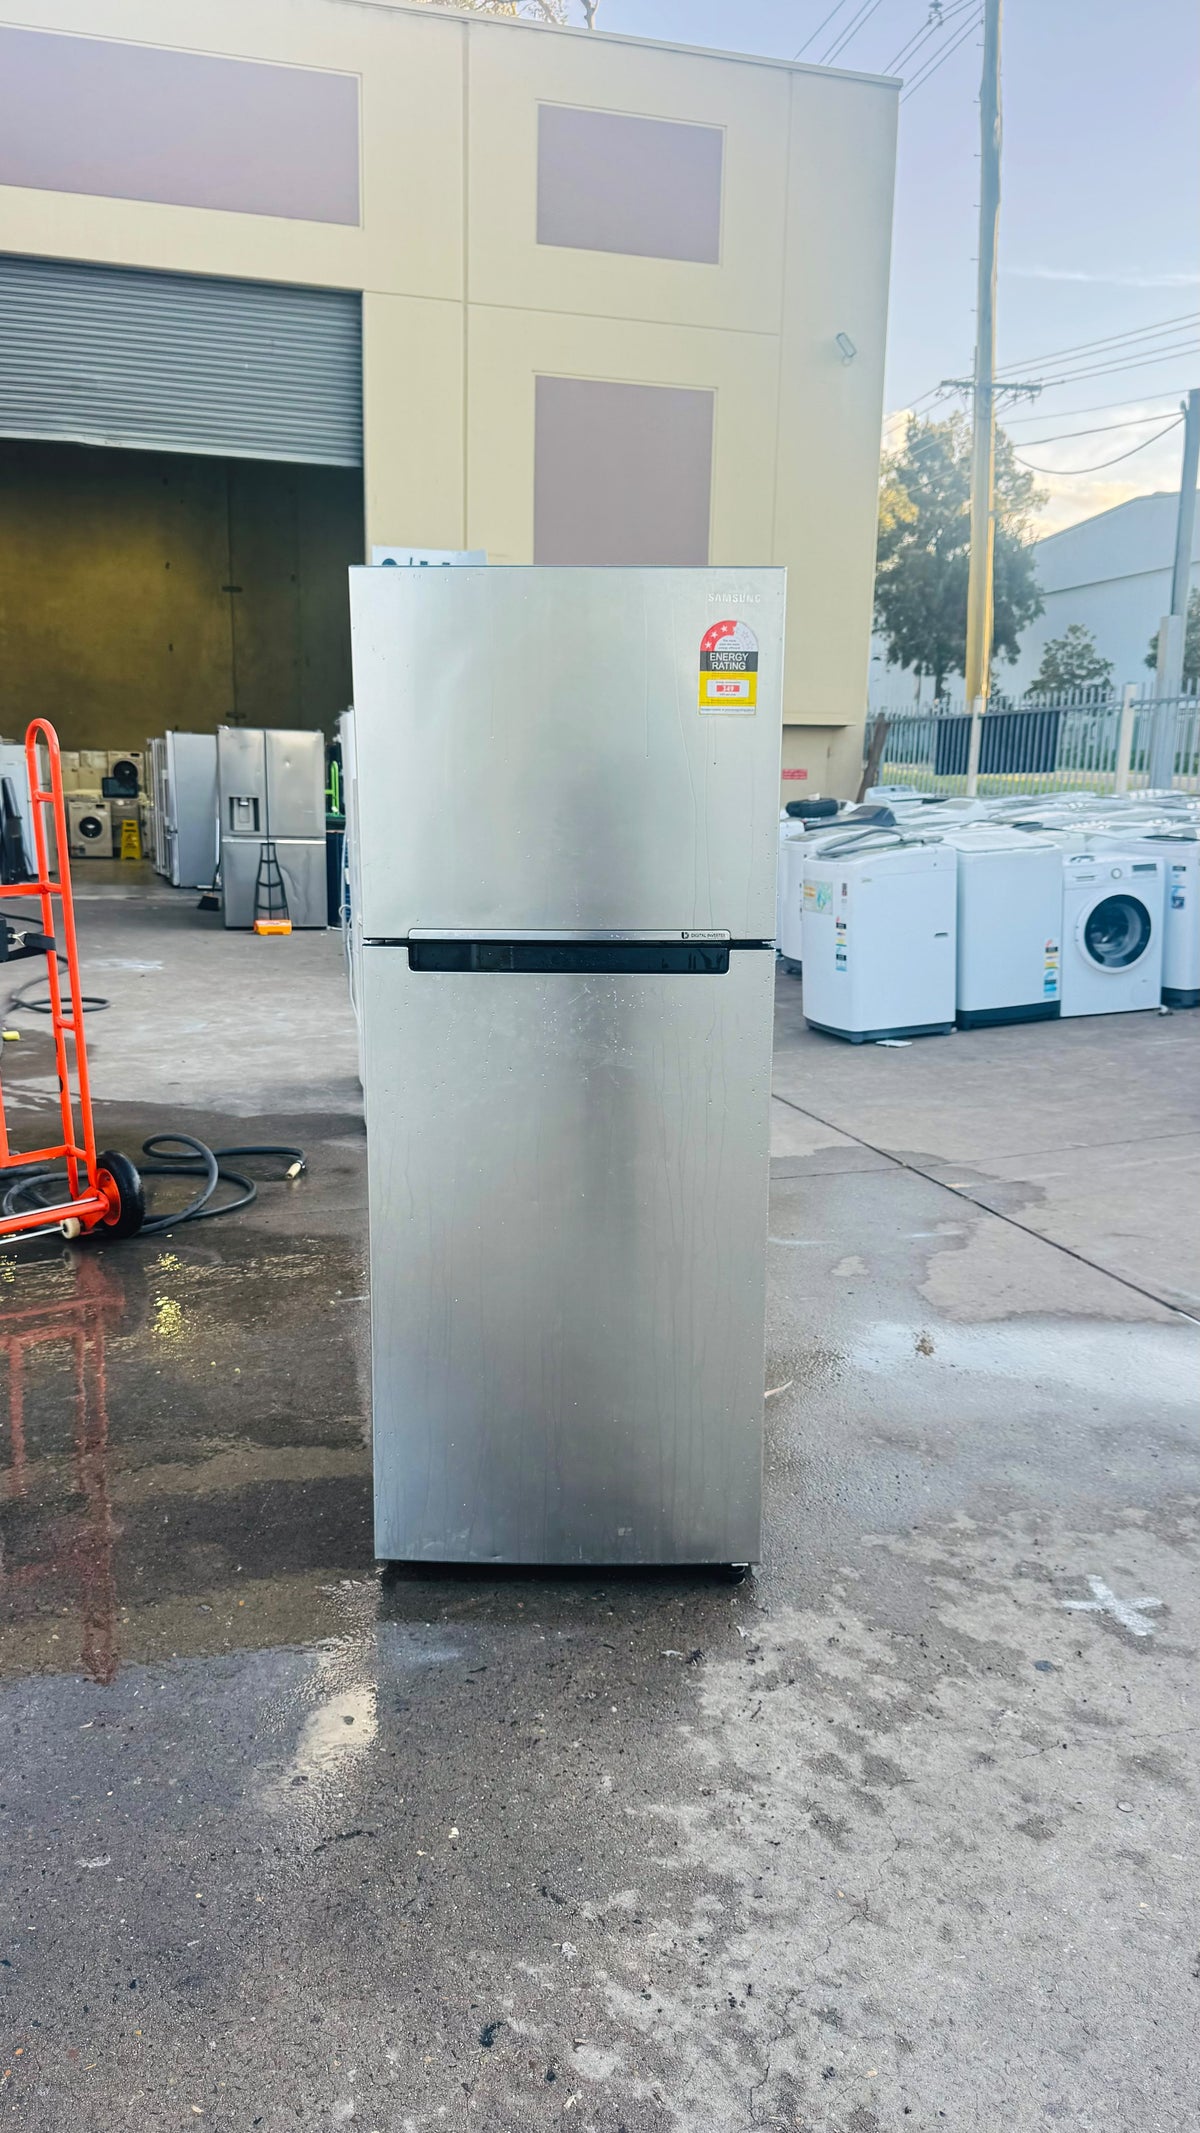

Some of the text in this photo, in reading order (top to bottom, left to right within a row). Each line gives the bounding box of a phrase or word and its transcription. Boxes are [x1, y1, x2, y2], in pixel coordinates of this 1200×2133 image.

[708, 593, 761, 603] SAMSUNG
[709, 652, 749, 662] ENERGY
[711, 661, 746, 671] RATING
